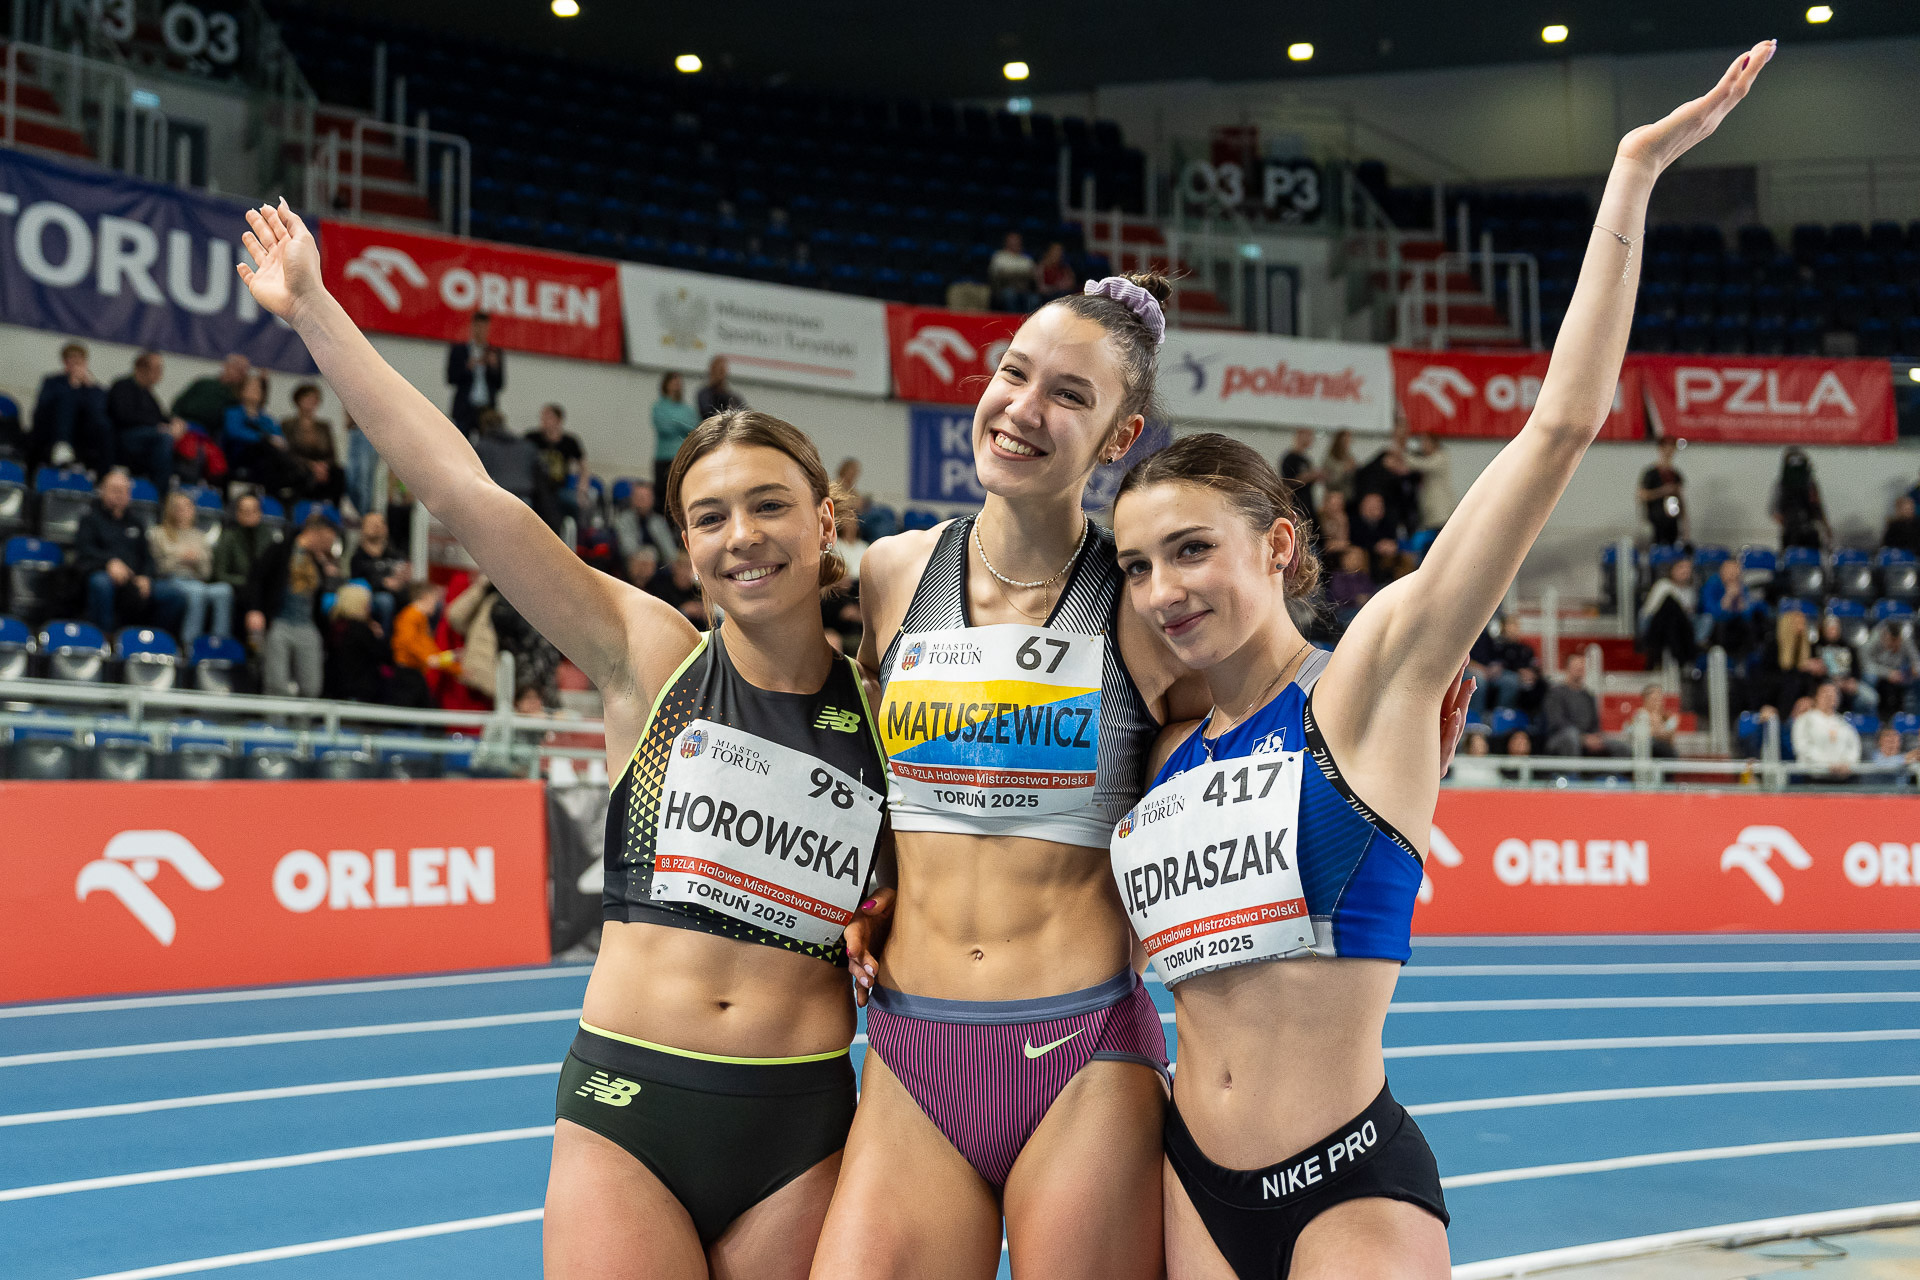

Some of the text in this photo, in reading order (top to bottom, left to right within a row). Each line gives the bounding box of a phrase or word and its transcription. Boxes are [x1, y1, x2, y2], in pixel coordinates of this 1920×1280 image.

[162, 3, 239, 63] O3
[1264, 165, 1319, 211] P3
[439, 267, 600, 329] ORLEN
[1220, 360, 1366, 402] polanik
[1674, 366, 1857, 416] PZLA
[928, 646, 983, 665] TORUŃ
[932, 642, 973, 651] MIASTO
[1016, 636, 1071, 673] 67
[888, 701, 1093, 749] MATUSZEWICZ
[711, 746, 771, 776] TORUŃ
[716, 739, 760, 759] MIASTO
[808, 767, 855, 810] 98
[912, 768, 935, 780] PZLA
[936, 771, 975, 782] Halowe
[976, 773, 1049, 786] Mistrzostwa
[1052, 775, 1089, 786] Polski
[933, 790, 1039, 809] TORUŃ 2025
[1203, 761, 1283, 807] 417
[1141, 795, 1185, 827] TORUŃ
[1144, 794, 1177, 812] MIASTO
[664, 790, 860, 887] HOROWSKA
[272, 846, 496, 913] ORLEN
[1124, 827, 1289, 918] JĘDRASZAK
[1493, 837, 1650, 887] ORLEN
[661, 858, 847, 922] 69. PZLA Halowe Mistrzostwa Polski
[687, 881, 798, 929] TORUŃ 2025
[1162, 927, 1191, 946] Halowe
[1193, 912, 1259, 934] Mistrzostwa
[1261, 901, 1300, 920] Polski
[1164, 940, 1205, 972] TORUŃ
[1208, 934, 1254, 957] 2025
[1262, 1120, 1378, 1200] NIKE PRO
